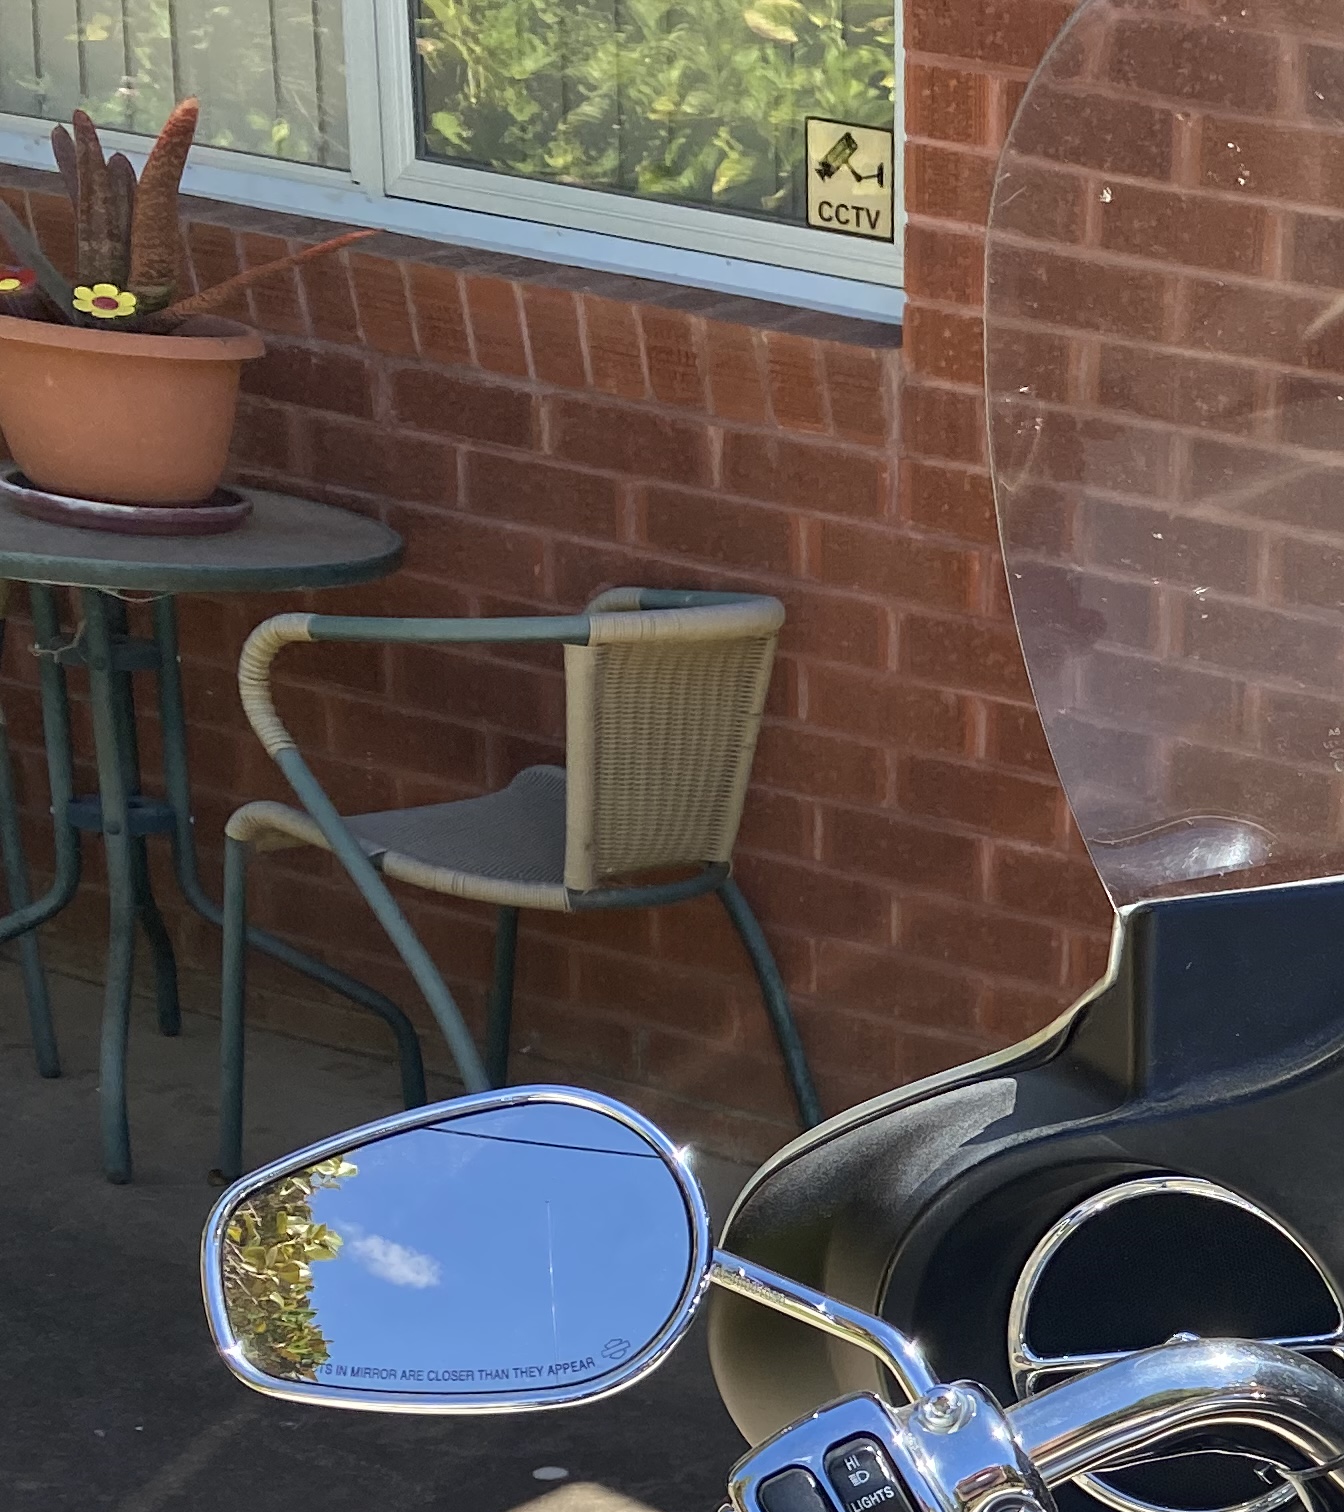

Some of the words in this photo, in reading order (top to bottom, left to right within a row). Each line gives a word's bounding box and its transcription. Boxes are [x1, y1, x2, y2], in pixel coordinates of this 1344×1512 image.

[818, 200, 880, 230] CCTV
[336, 1365, 348, 1377] IN
[350, 1366, 397, 1380] MIRROR
[400, 1369, 424, 1382] ARE
[426, 1369, 475, 1382] CLOSER
[477, 1368, 510, 1381] THAN
[512, 1366, 545, 1379] THEY
[546, 1356, 596, 1377] APPEAR
[845, 1454, 860, 1472] HI
